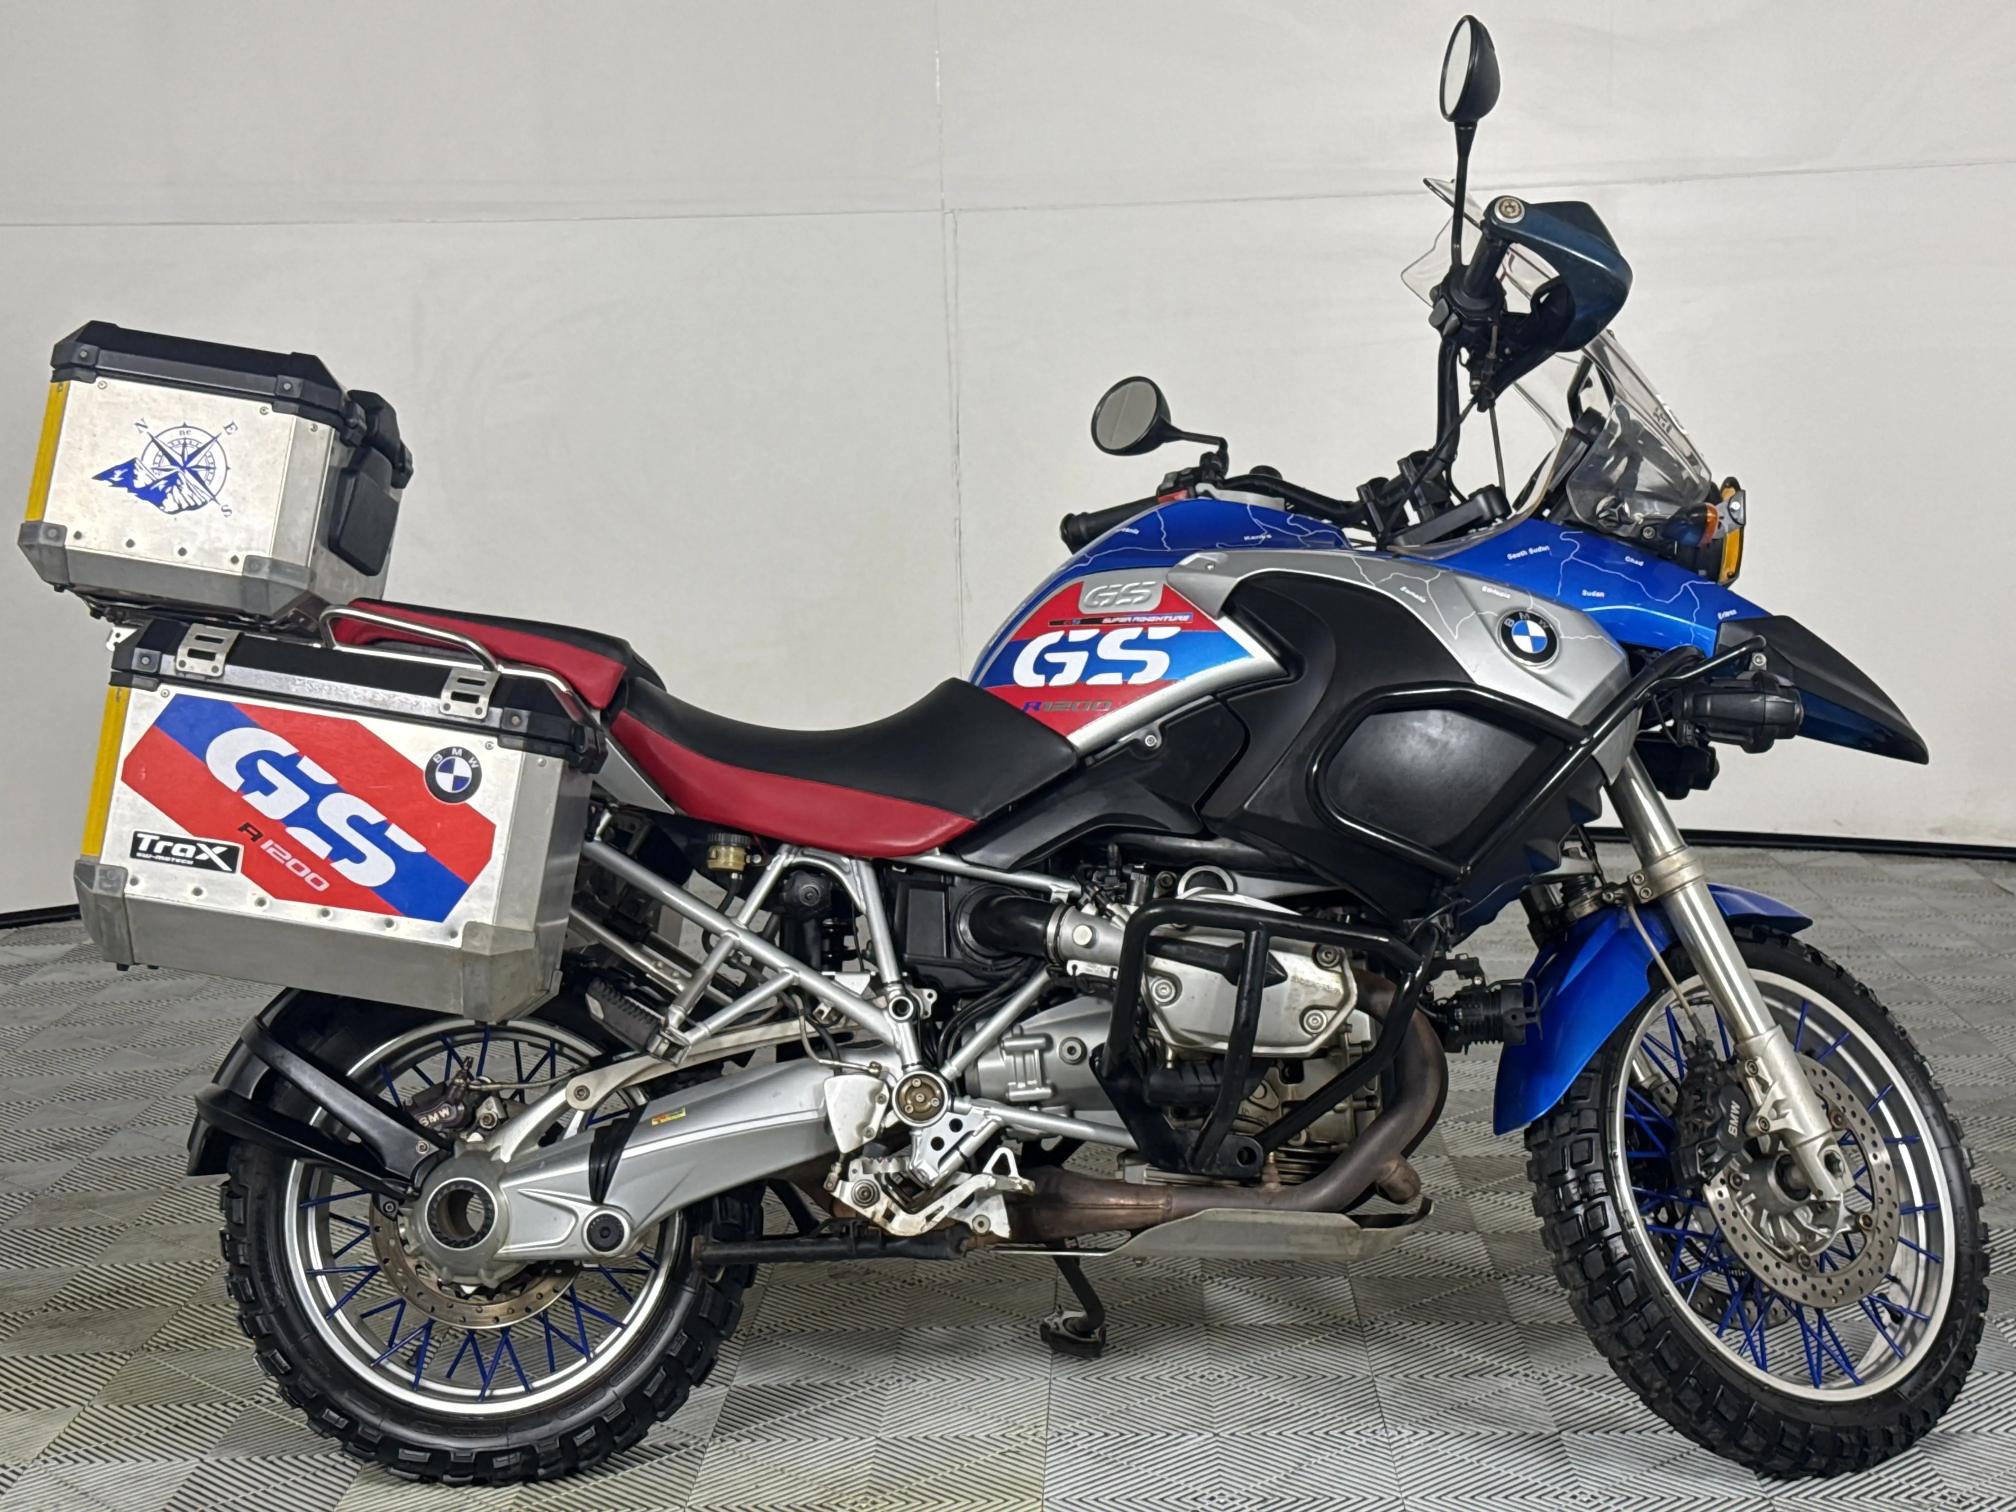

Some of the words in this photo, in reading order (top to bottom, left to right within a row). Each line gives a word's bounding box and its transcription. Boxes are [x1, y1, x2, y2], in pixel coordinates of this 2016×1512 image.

[223, 421, 239, 436] E
[220, 504, 233, 518] S
[1506, 549, 1528, 560] South
[1528, 544, 1551, 555] Sudan
[1083, 580, 1157, 608] GS
[1581, 589, 1605, 598] Sudan
[1102, 615, 1132, 624] SUPER
[1012, 626, 1183, 688] GS
[432, 747, 480, 769] BMW
[205, 726, 427, 887] GS
[136, 833, 233, 872] TraX
[1728, 1100, 1741, 1137] BMW
